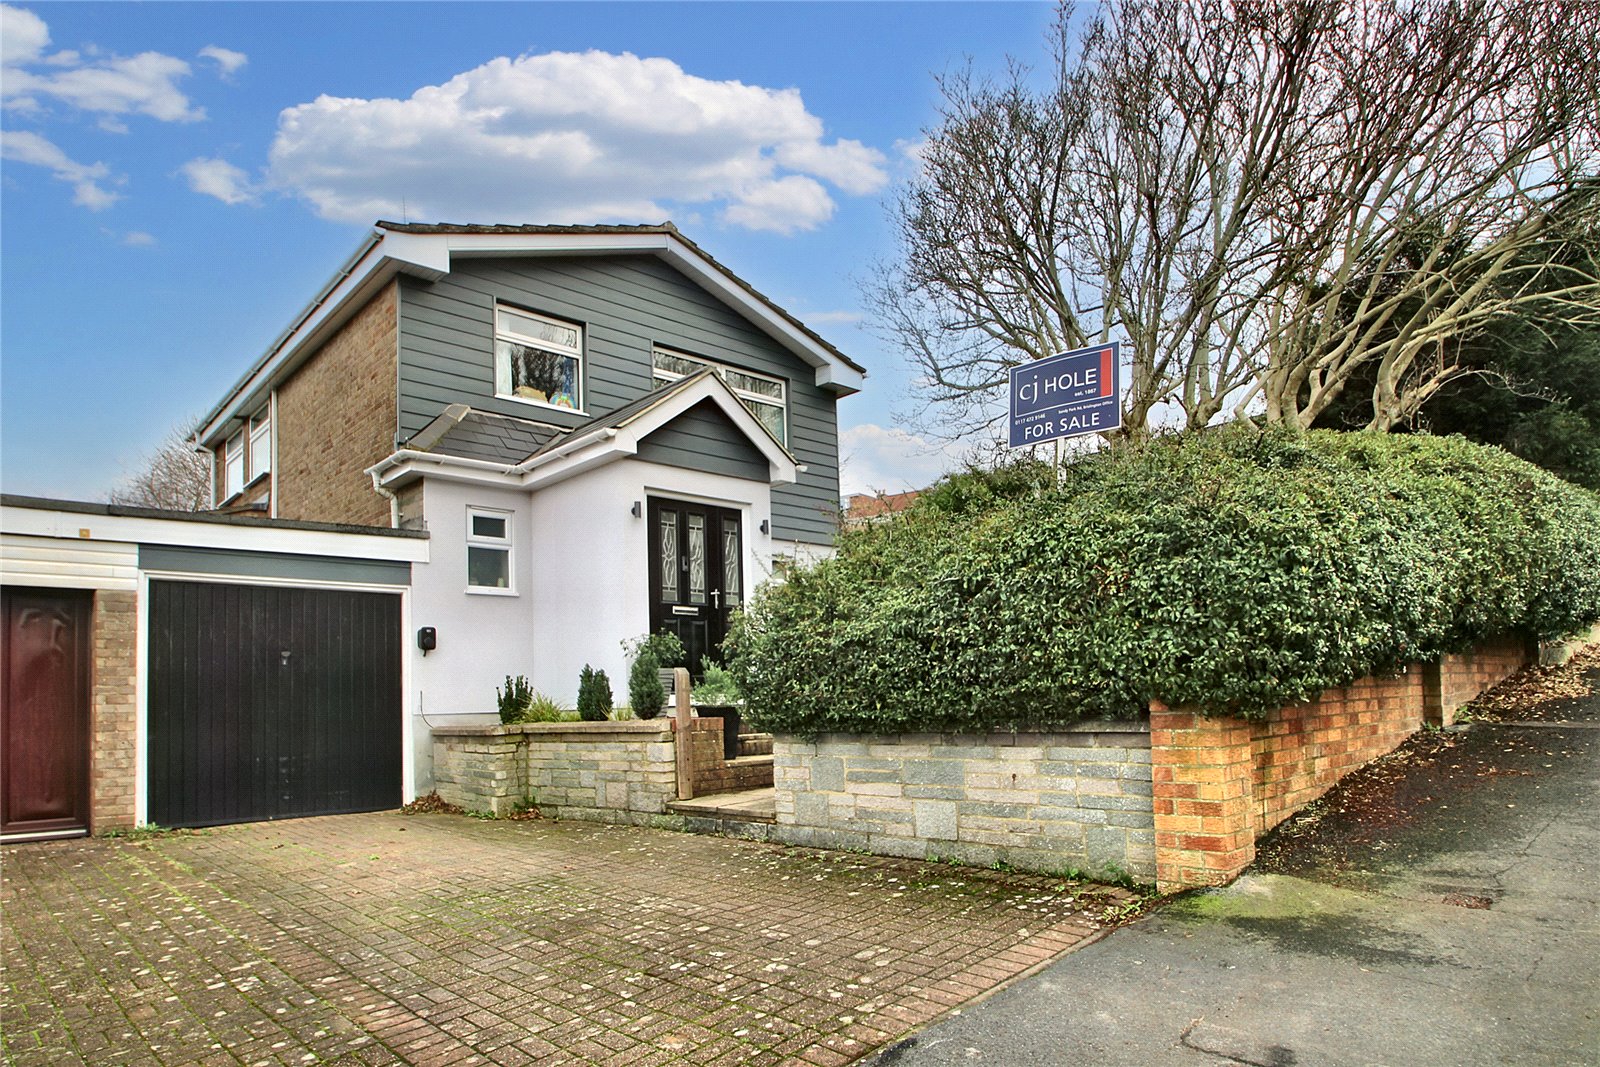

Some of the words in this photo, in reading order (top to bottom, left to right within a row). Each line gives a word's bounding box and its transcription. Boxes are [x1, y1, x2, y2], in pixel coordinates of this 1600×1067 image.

[1044, 368, 1097, 394] HOLE
[1025, 421, 1054, 440] FOR
[1060, 412, 1100, 432] SALE
